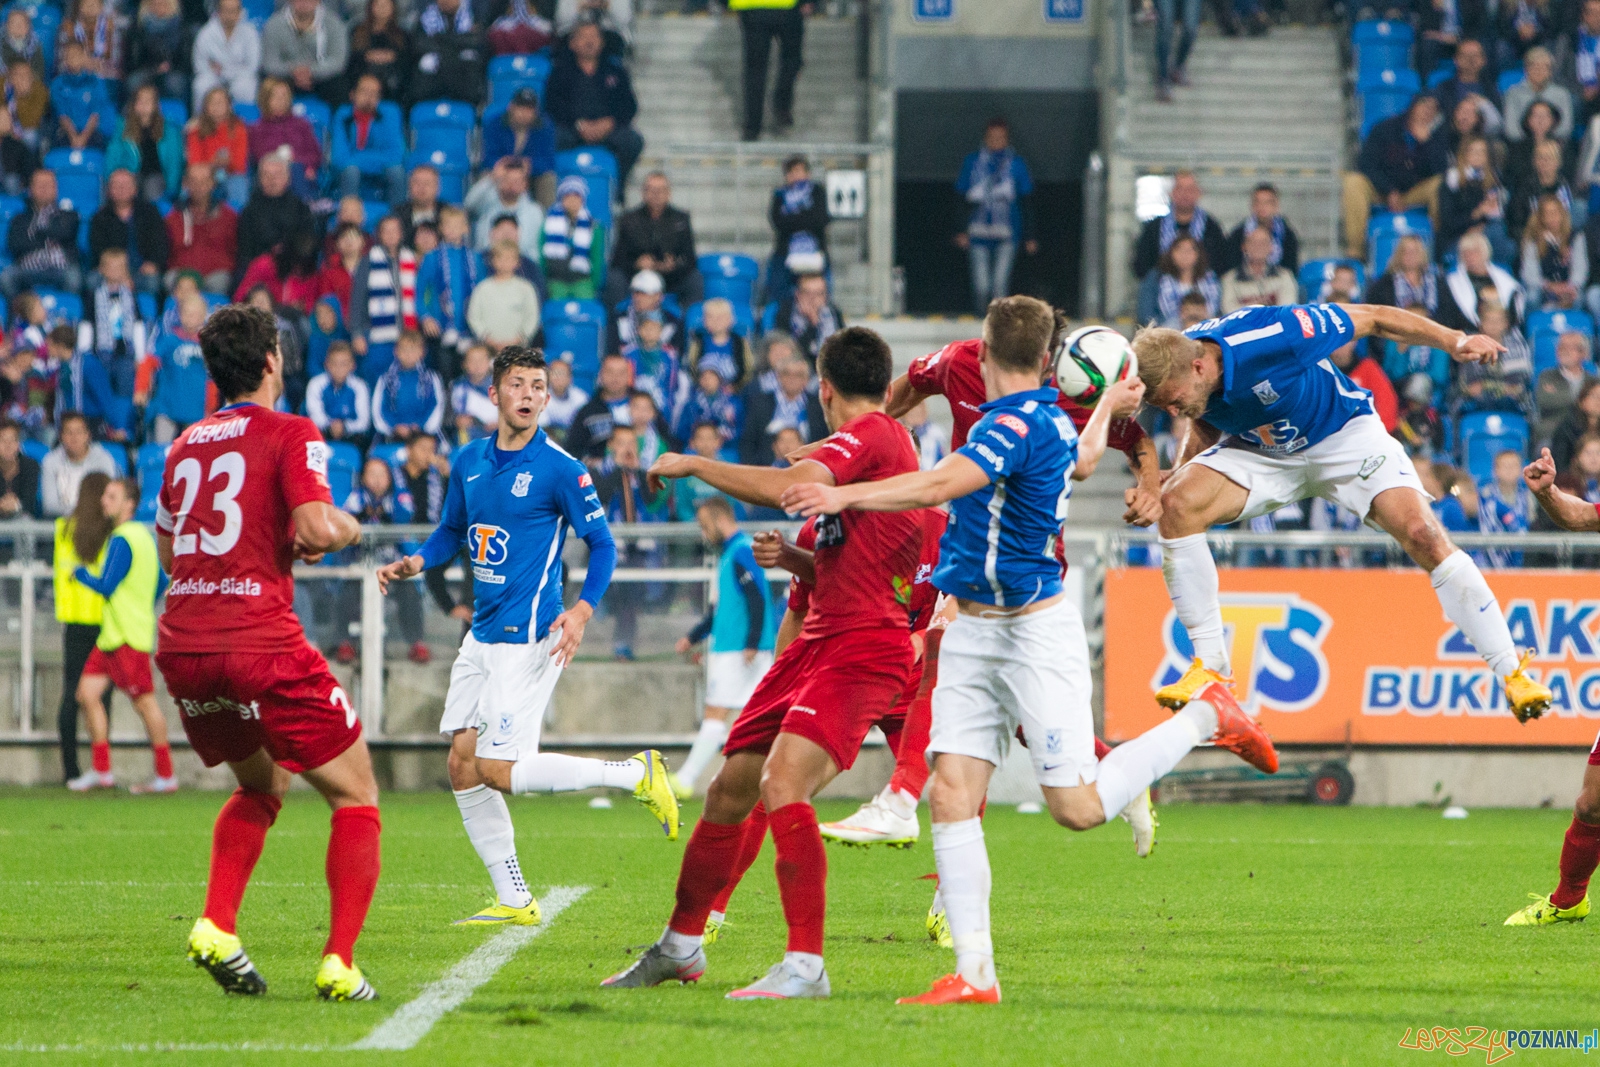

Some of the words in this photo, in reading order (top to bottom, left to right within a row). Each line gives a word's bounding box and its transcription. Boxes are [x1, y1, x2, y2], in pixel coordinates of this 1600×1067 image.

[187, 416, 252, 445] DEMJAN
[172, 450, 246, 558] 23
[467, 523, 511, 566] STS
[169, 577, 262, 597] Bielsko-Biała
